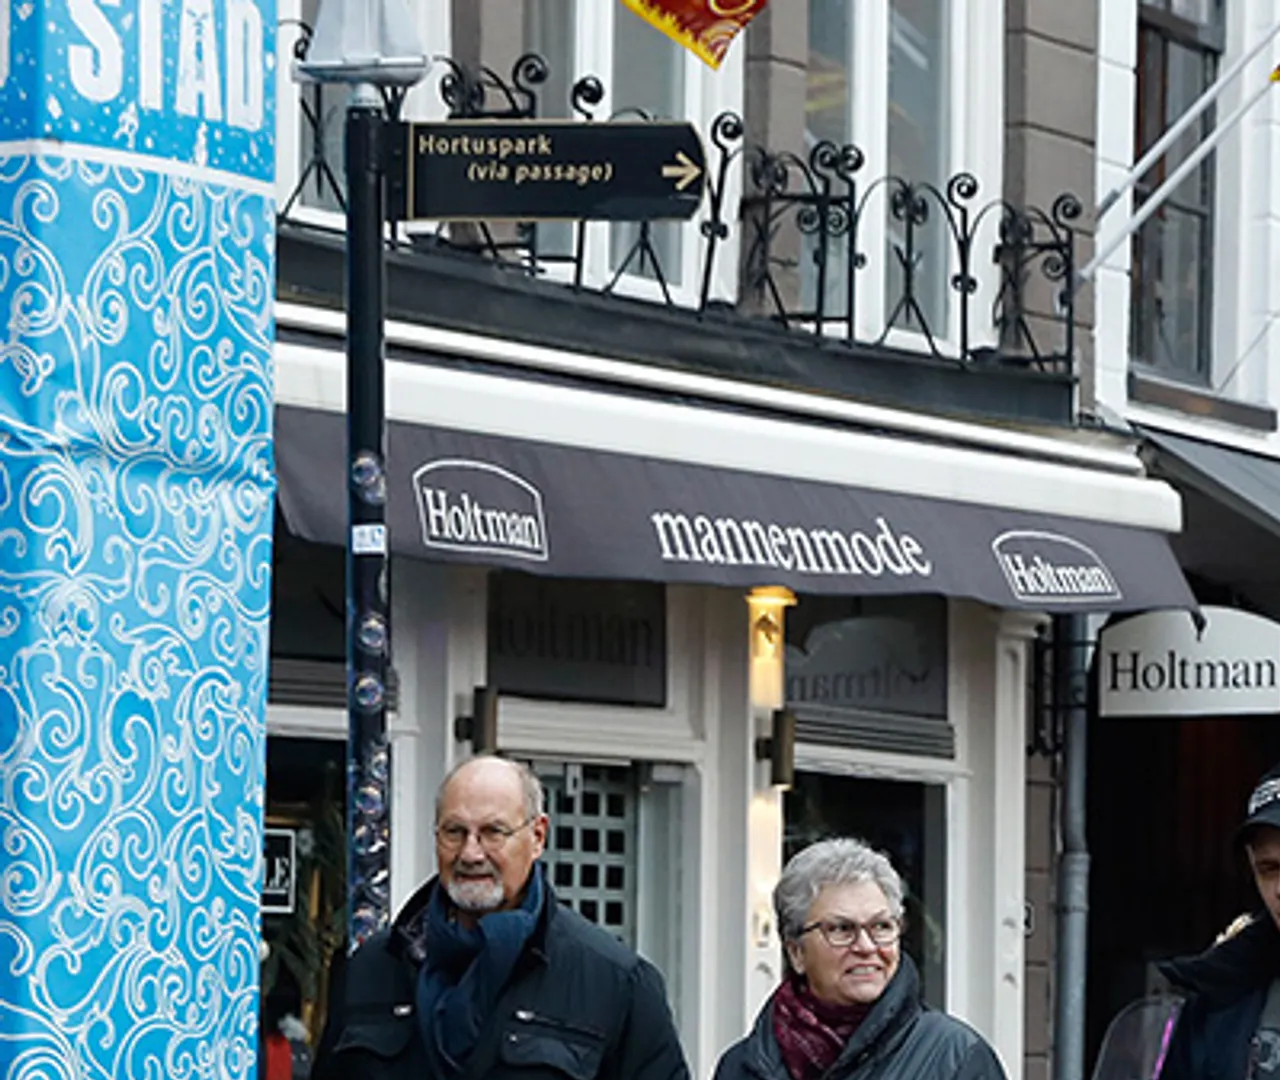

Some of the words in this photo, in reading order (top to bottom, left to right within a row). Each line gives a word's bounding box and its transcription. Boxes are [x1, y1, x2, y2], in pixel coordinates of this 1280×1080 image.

[418, 134, 552, 159] Hortuspark
[467, 161, 509, 182] (via
[514, 163, 614, 186] passage)
[423, 486, 542, 549] Holtman
[651, 512, 933, 576] mannenmode
[1004, 552, 1113, 594] Holtman
[1108, 649, 1277, 692] Holtman
